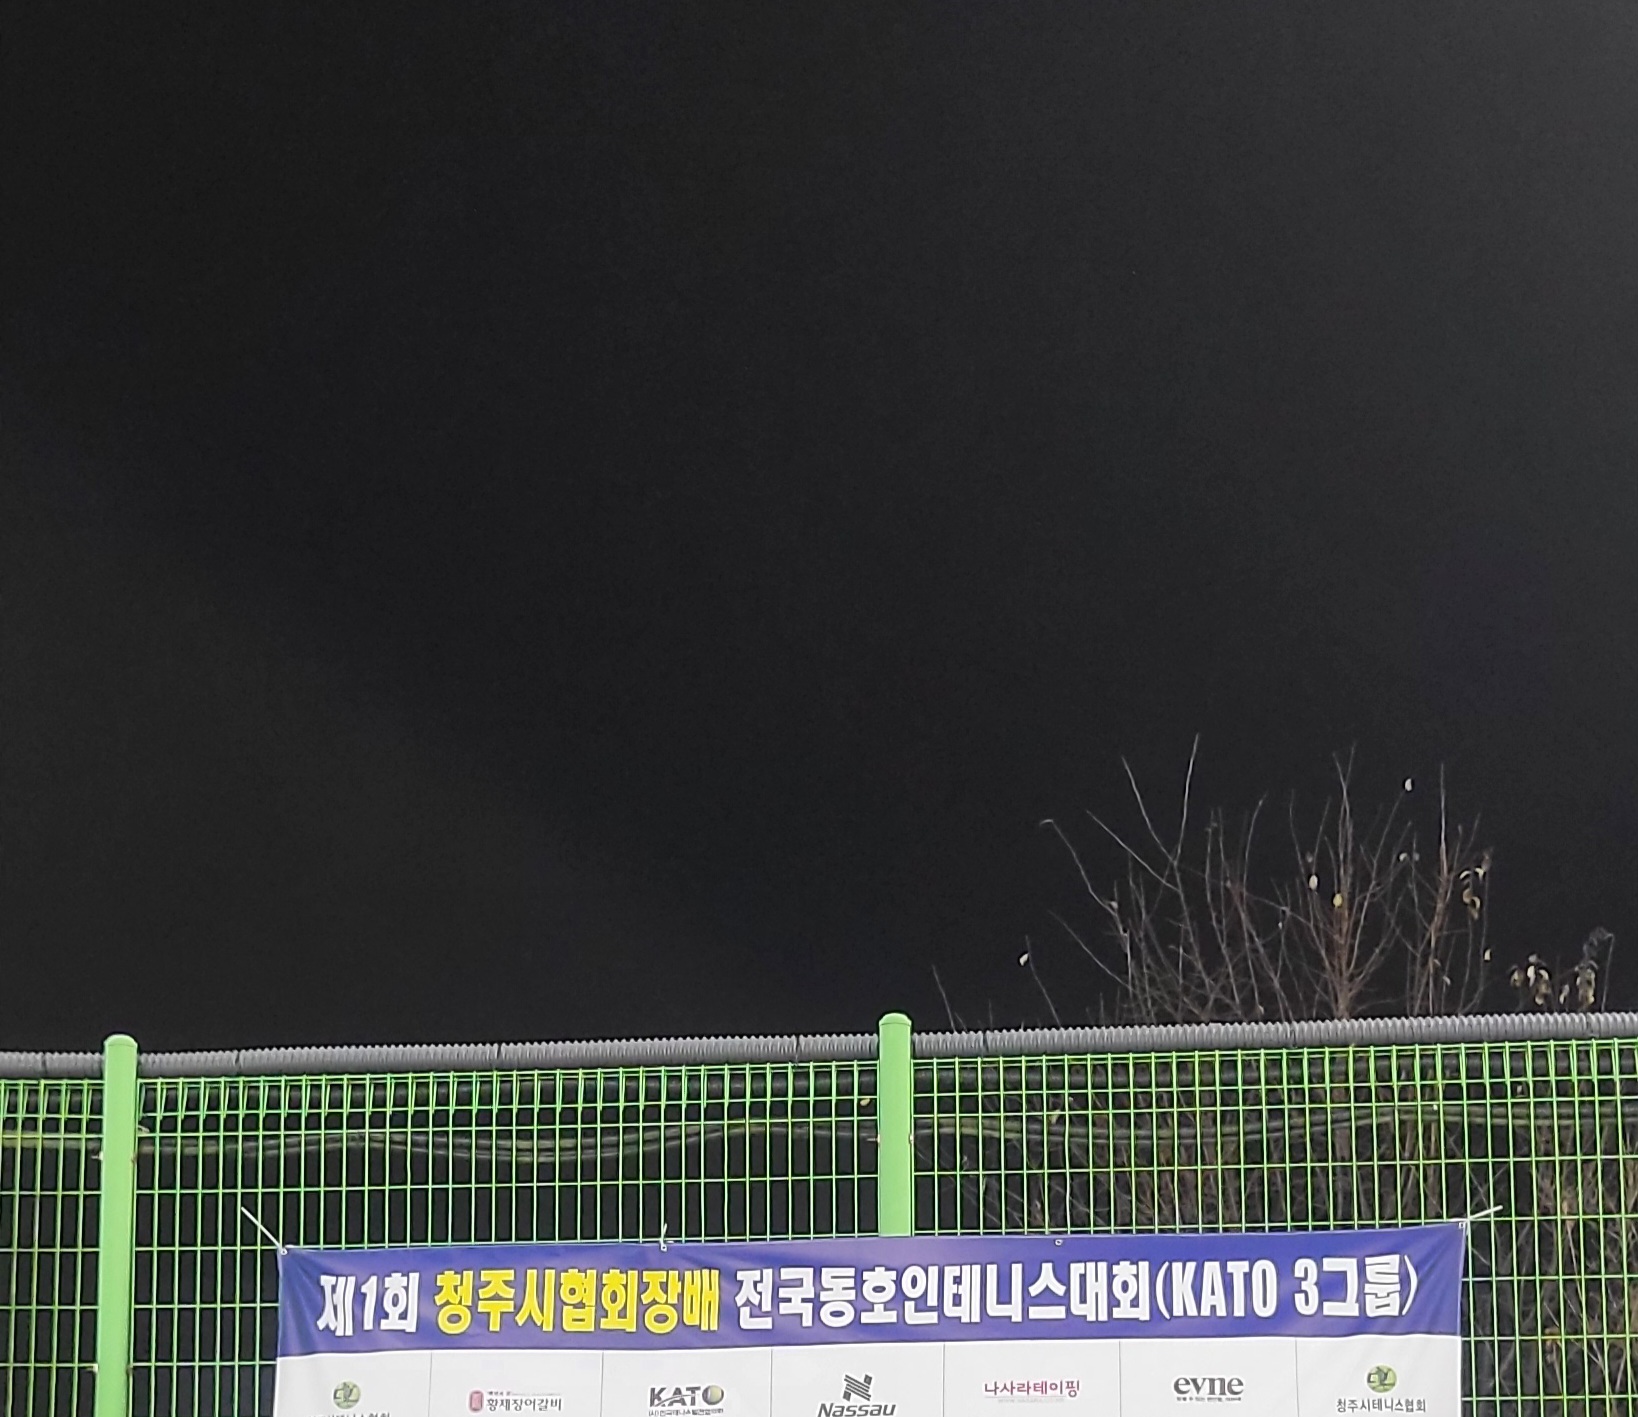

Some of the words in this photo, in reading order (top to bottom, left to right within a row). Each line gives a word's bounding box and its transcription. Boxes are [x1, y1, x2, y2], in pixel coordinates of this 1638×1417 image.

[317, 1272, 420, 1336] 제1회
[434, 1268, 720, 1335] 청주시협회장배
[734, 1260, 1277, 1330] 전국동호인테니스대회(KATO
[1293, 1254, 1418, 1317] 3그룹)
[984, 1380, 1081, 1397] 나사라테이핑
[1173, 1376, 1244, 1396] evne
[487, 1398, 562, 1411] 황제장어갈비
[650, 1385, 724, 1407] KATO
[1336, 1398, 1427, 1413] 청주시테니스협회
